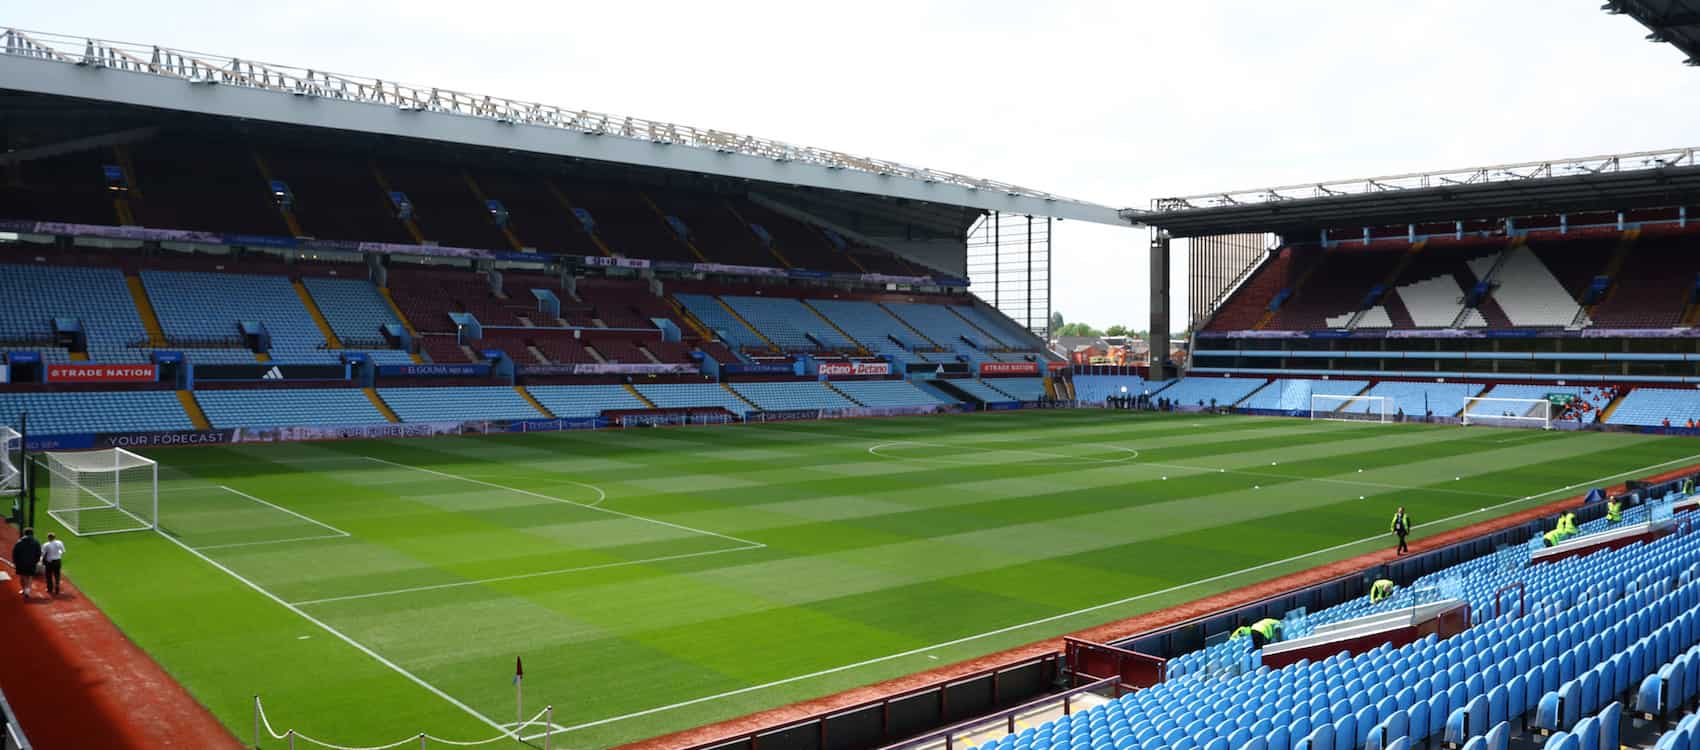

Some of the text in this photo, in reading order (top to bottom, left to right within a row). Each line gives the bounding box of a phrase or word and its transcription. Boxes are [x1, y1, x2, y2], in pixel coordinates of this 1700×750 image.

[62, 369, 103, 377] TRADE
[111, 433, 225, 446] YOUR FORECAST
